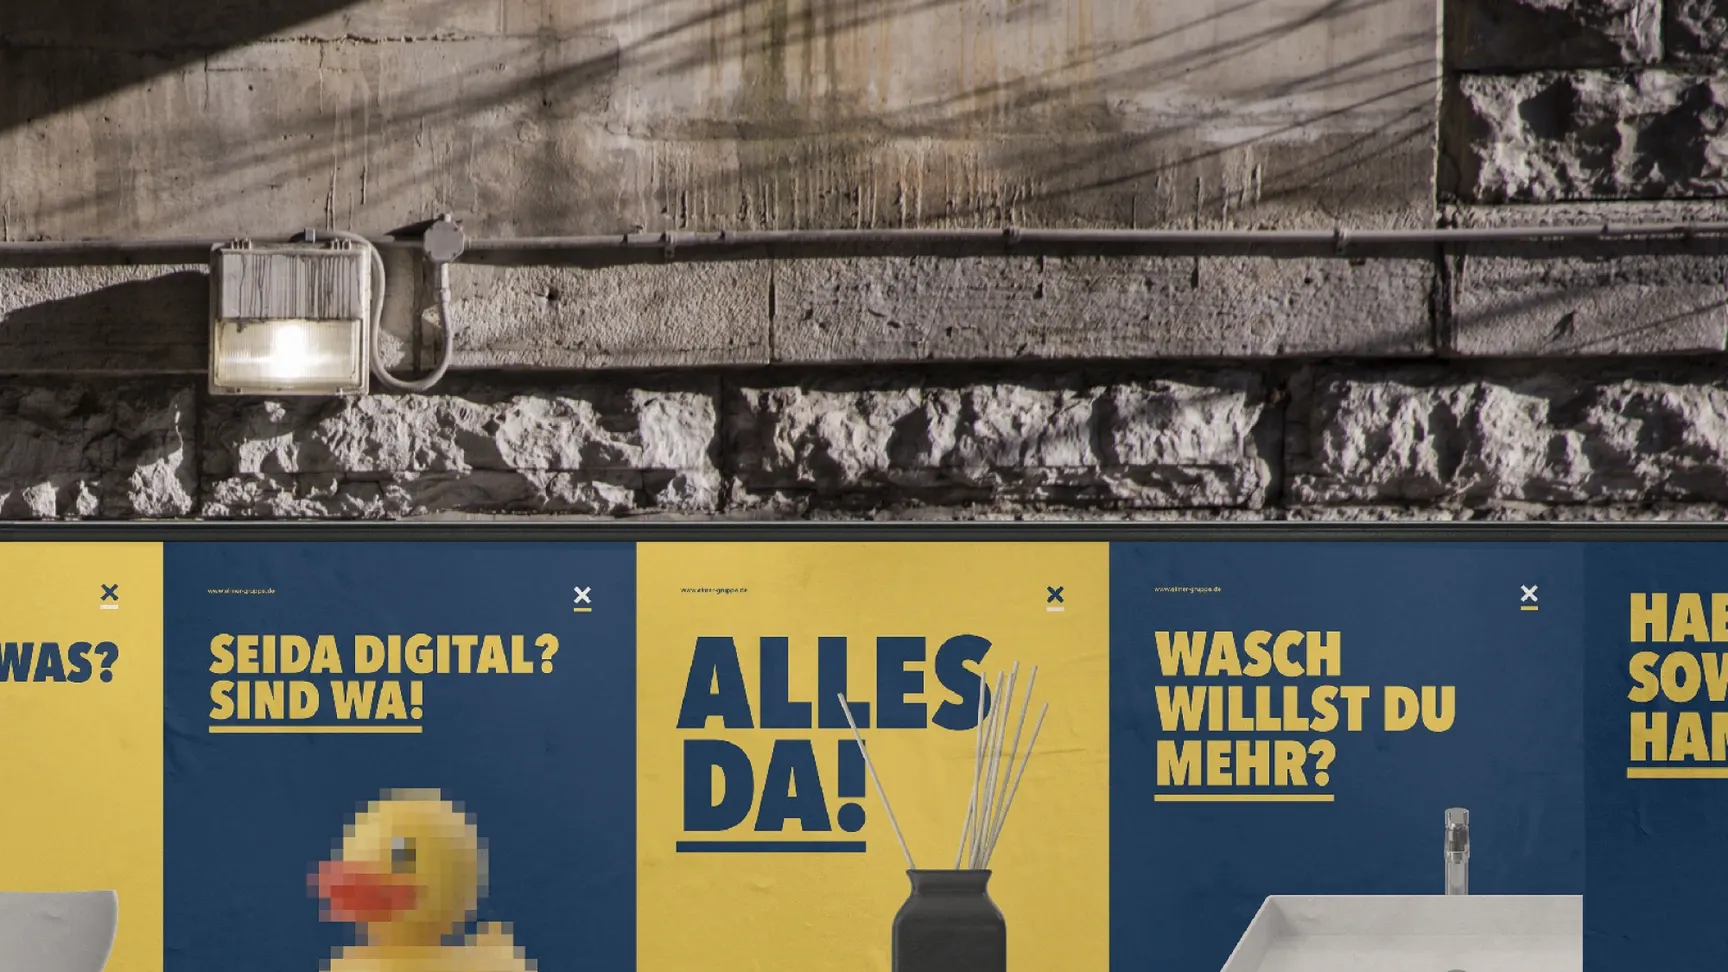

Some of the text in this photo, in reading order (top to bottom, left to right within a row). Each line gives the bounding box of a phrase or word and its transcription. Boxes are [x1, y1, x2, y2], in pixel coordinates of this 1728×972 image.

[209, 634, 558, 674] SEIDA DIGITAL?
[1155, 630, 1340, 677] WASCH
[209, 680, 423, 719] SIND WA!
[675, 634, 992, 731] ALLES
[1155, 686, 1455, 732] WILLLST DU
[684, 738, 867, 832] DA!
[1157, 739, 1336, 786] MEHR?
